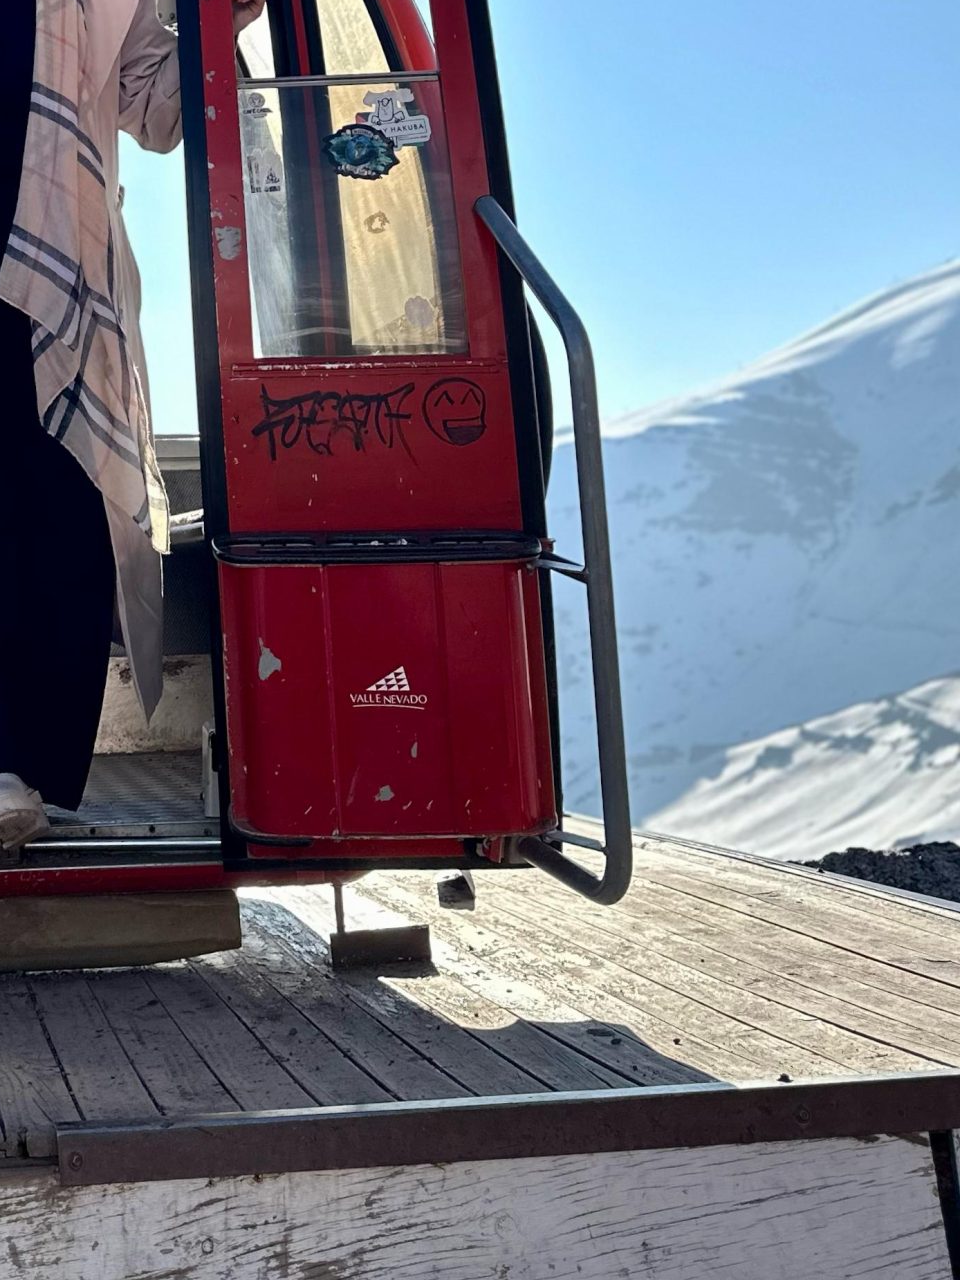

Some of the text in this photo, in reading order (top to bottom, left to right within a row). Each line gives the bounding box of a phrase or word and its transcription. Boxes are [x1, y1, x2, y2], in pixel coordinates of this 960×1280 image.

[390, 123, 424, 133] HAKUBA
[349, 693, 428, 705] VALLE NEVADO
